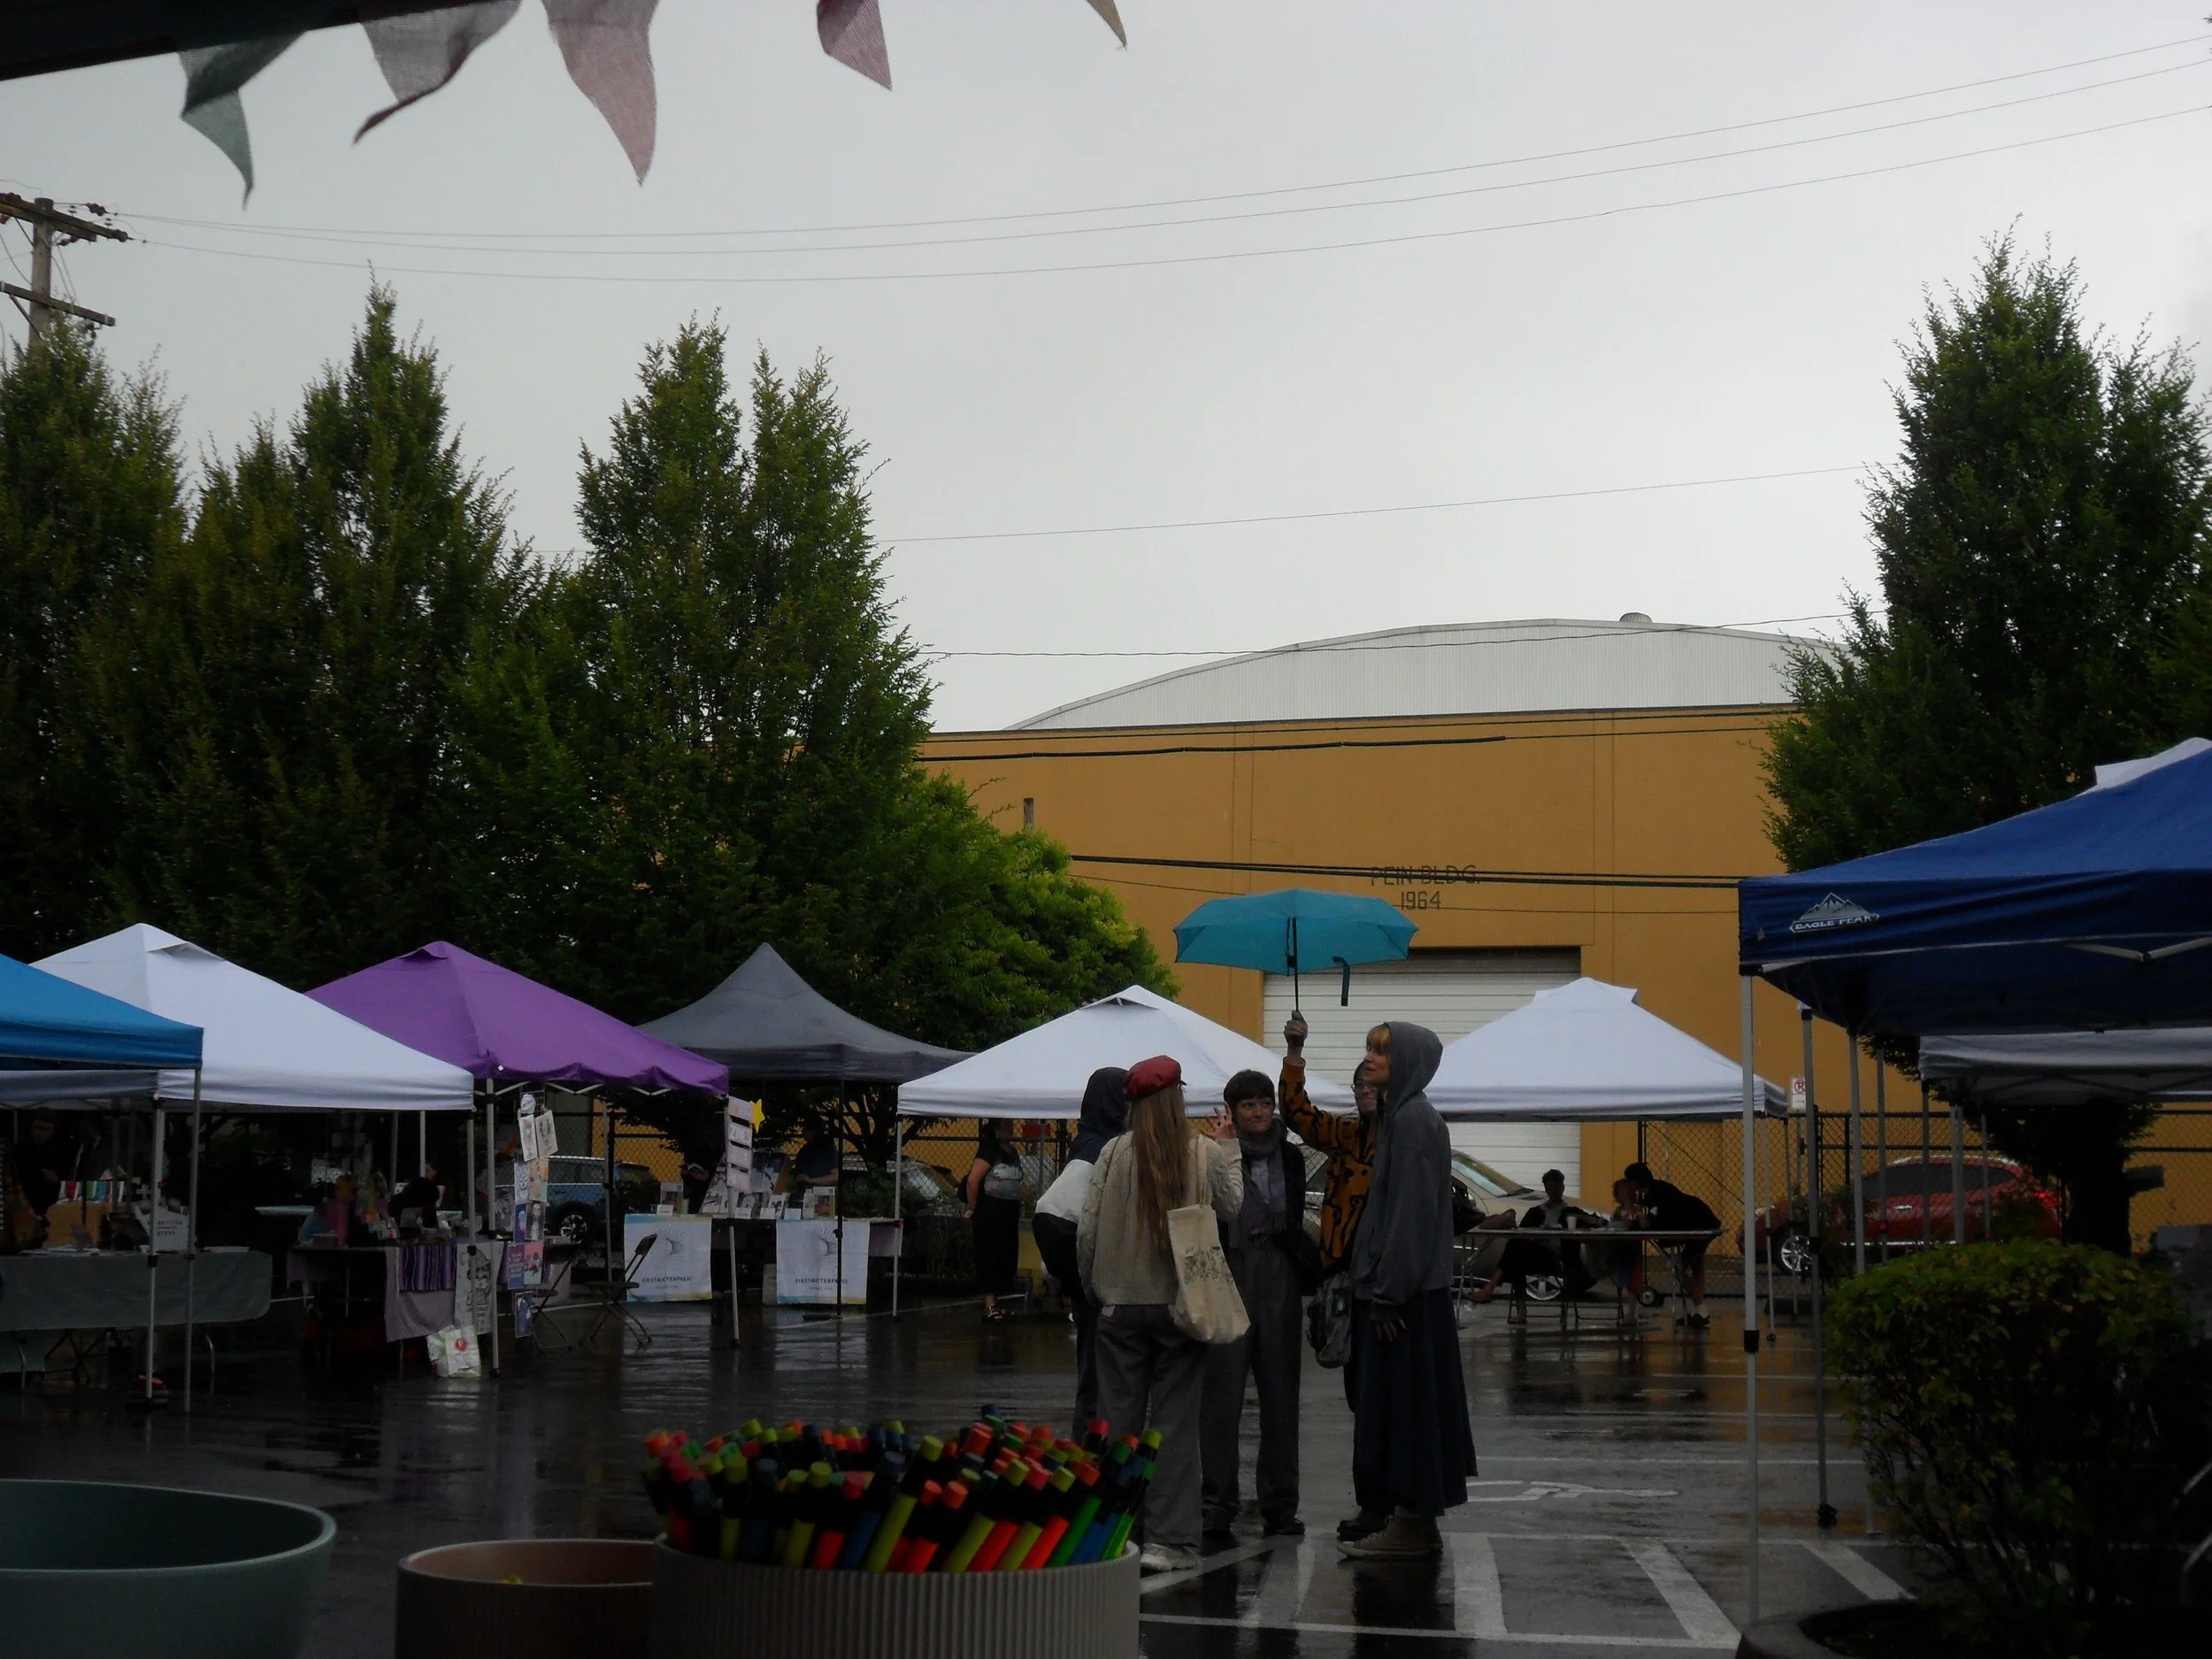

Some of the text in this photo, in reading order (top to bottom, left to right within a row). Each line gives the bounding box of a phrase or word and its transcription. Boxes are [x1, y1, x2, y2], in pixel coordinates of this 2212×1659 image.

[1402, 890, 1441, 910] 1964
[1794, 915, 1872, 930] EAGLE PEAK
